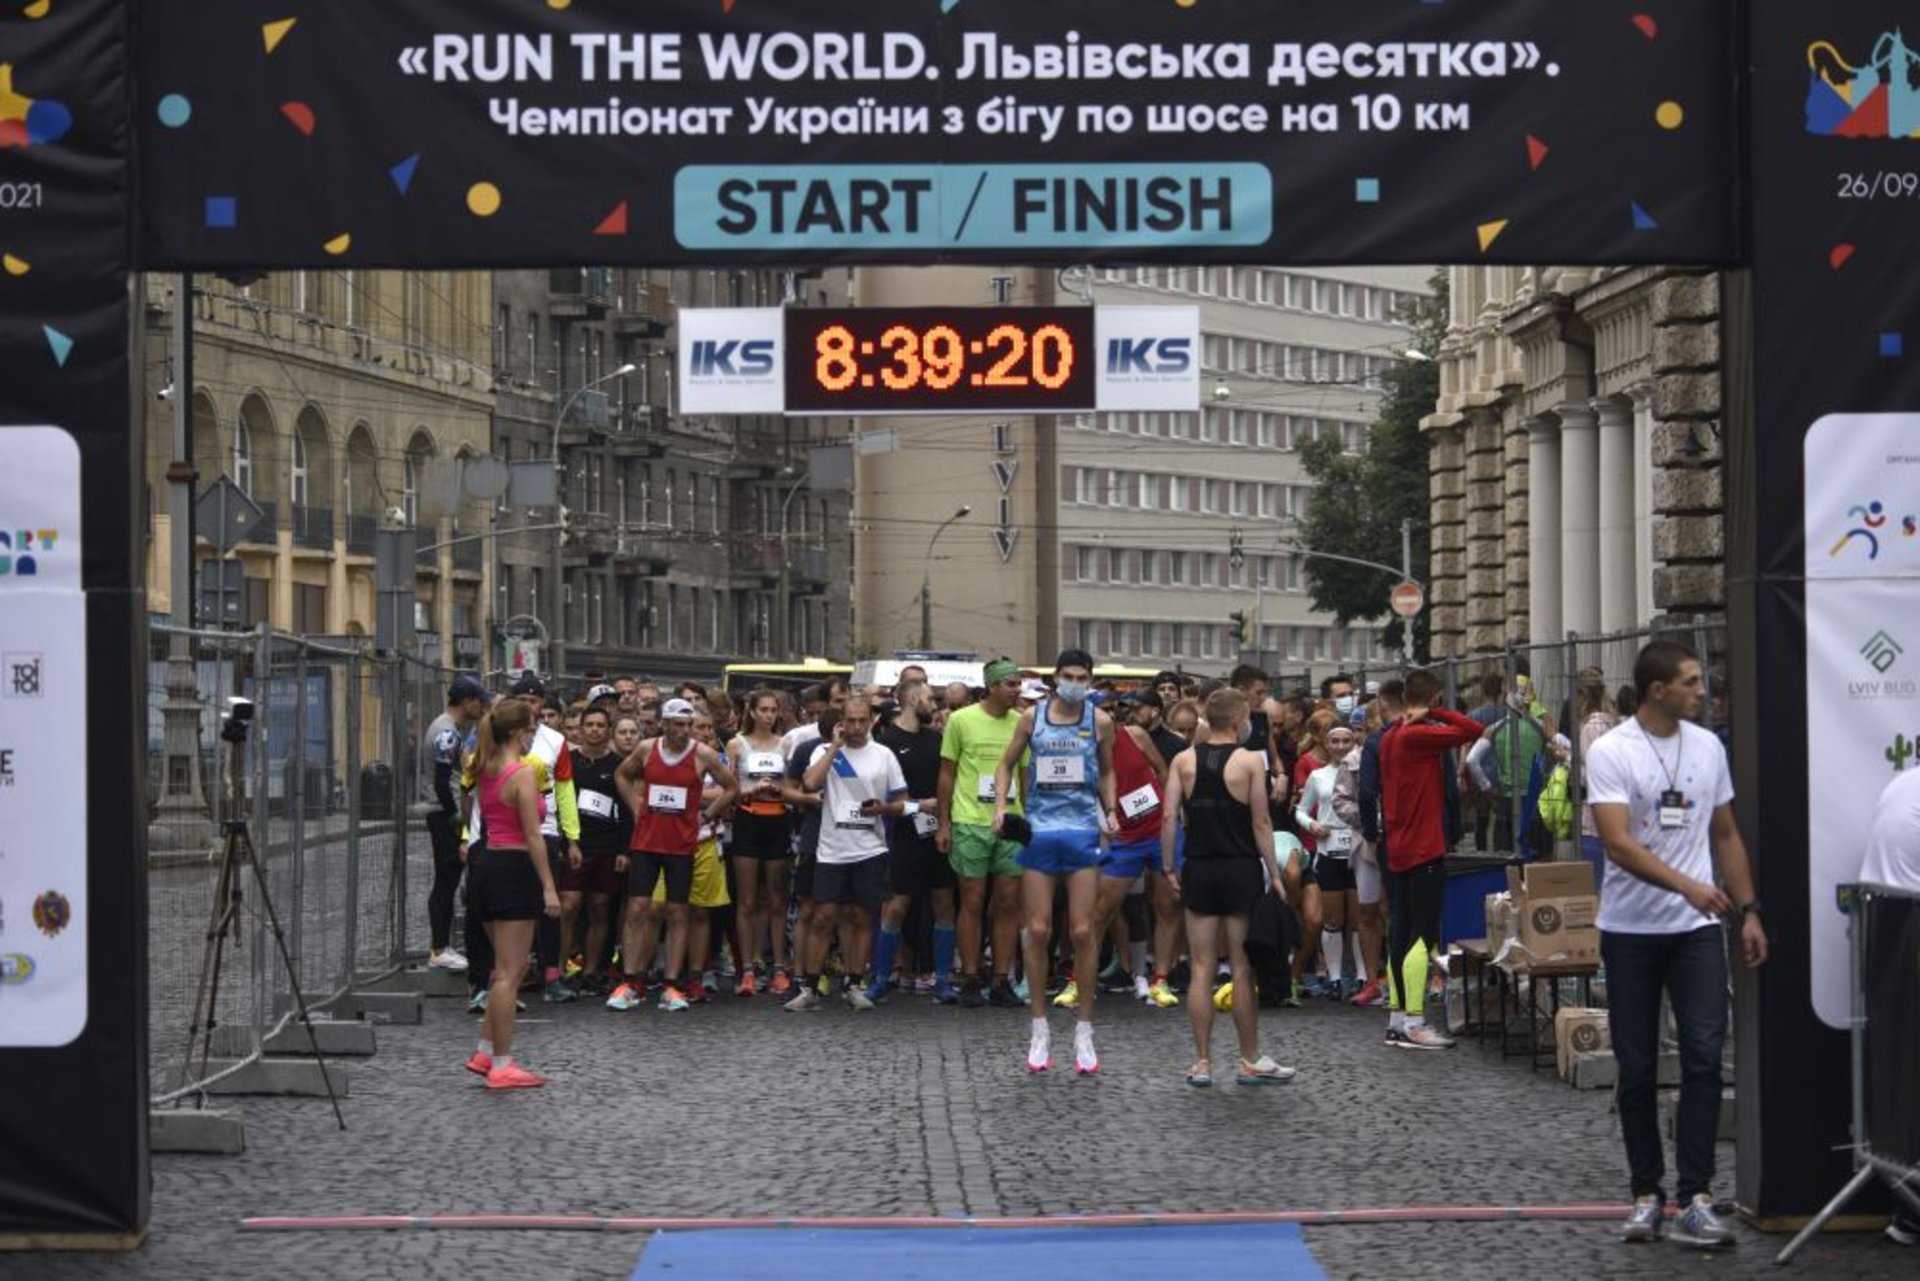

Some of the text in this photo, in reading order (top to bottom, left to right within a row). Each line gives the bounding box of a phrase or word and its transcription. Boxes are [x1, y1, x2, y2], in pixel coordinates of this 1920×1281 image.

[398, 30, 1560, 86] «RUN THE WORLD. Львівська десятка».
[489, 93, 1470, 144] Чемпіонат України з бігу по шосе на 10 км
[716, 179, 932, 235] START
[1013, 177, 1232, 233] FINISH
[1837, 171, 1920, 200] 26/09
[690, 339, 775, 376] IKS
[815, 324, 1074, 391] 8:39:20
[1106, 337, 1191, 374] IKS
[988, 423, 1018, 563] LVIV
[1848, 682, 1880, 694] LVIV
